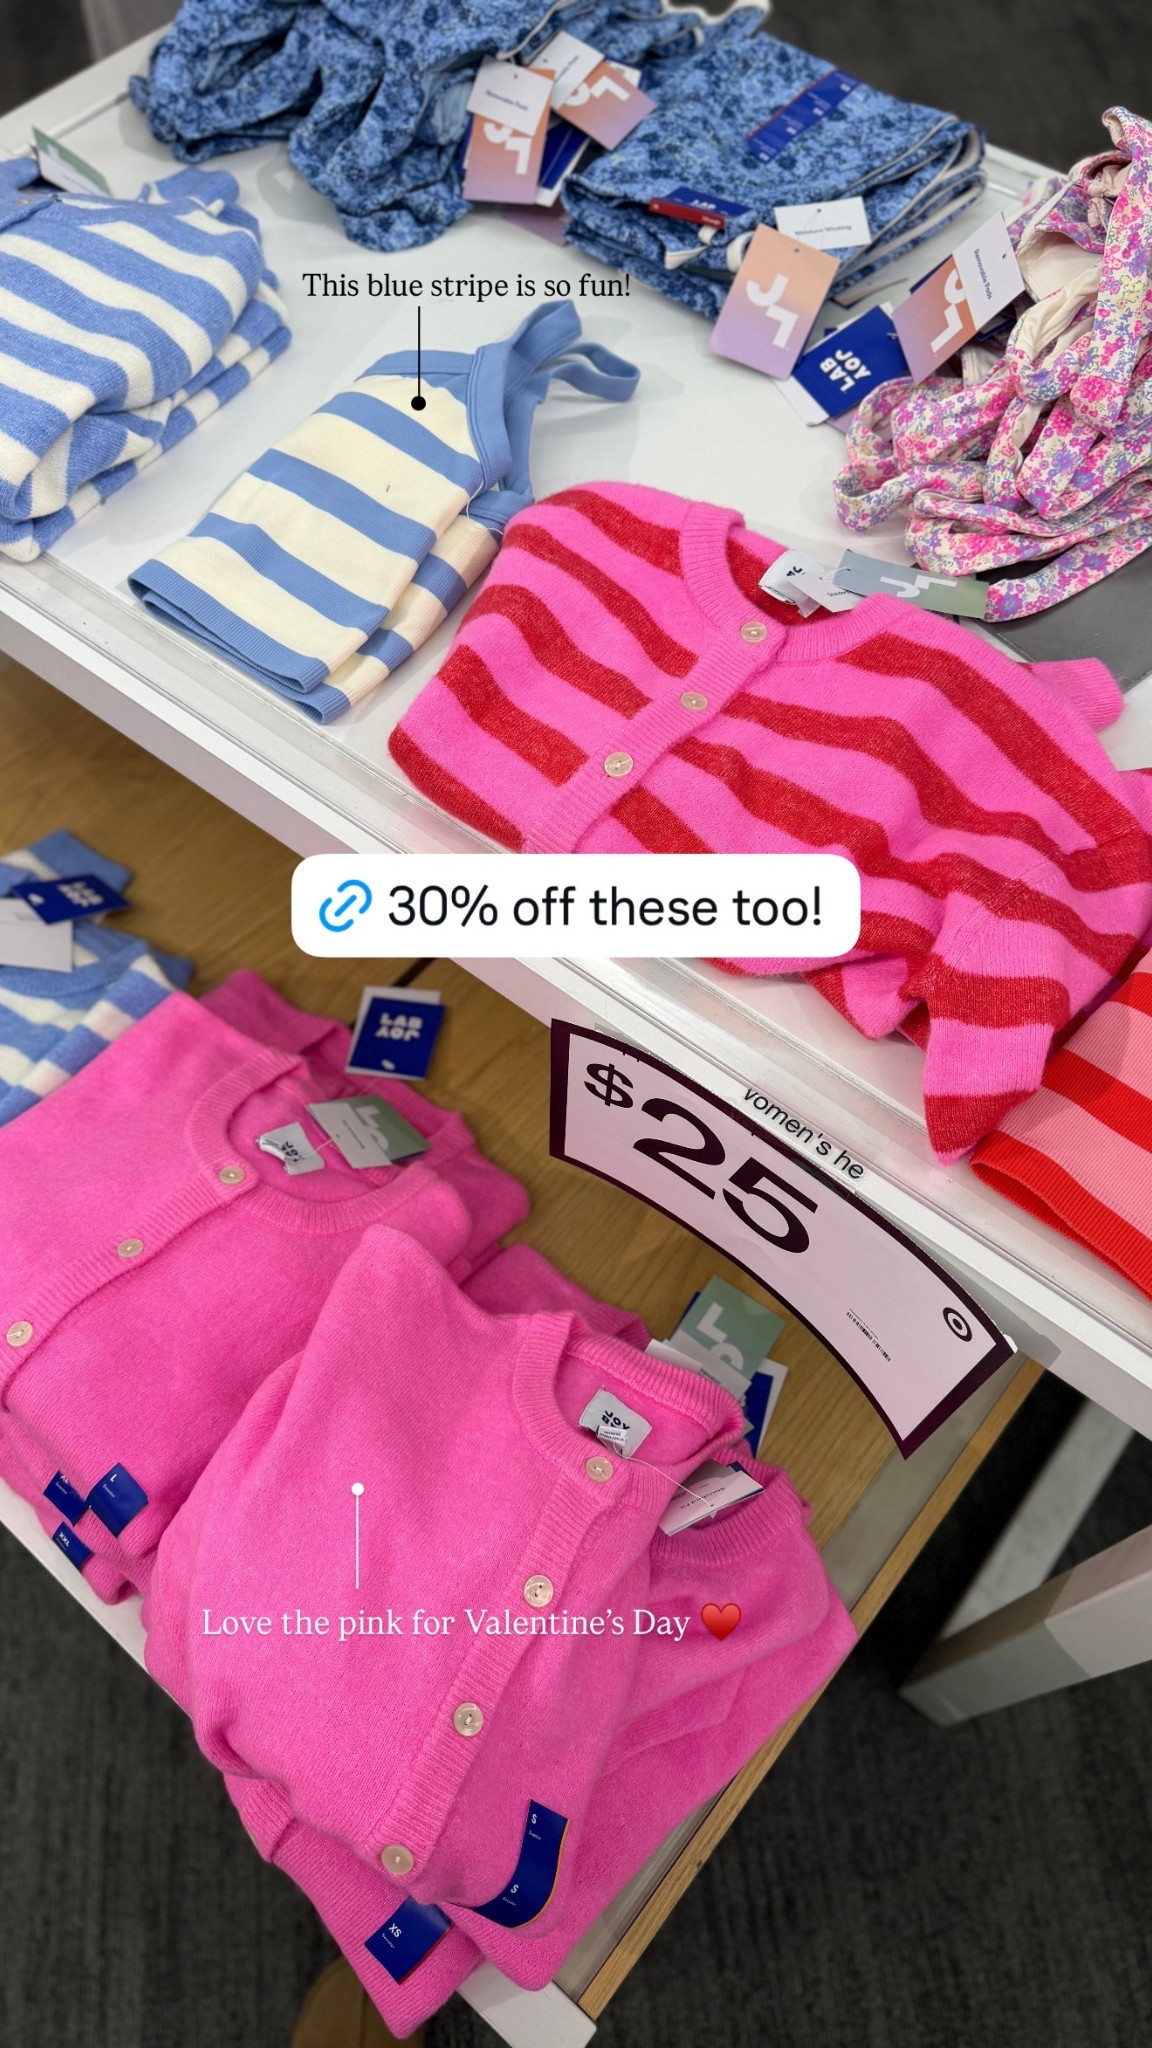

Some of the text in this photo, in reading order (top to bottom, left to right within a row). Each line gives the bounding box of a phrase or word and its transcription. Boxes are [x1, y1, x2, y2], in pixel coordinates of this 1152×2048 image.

[974, 248, 987, 283] Removable
[835, 349, 872, 380] JOY
[820, 356, 855, 393] LAB
[380, 1012, 423, 1031] LAB
[374, 1025, 420, 1042] JOY
[584, 1062, 818, 1254] $25
[605, 1410, 631, 1430] JOY
[109, 1473, 117, 1482] L
[59, 1532, 70, 1547] XXL
[531, 1814, 537, 1824] S
[510, 1884, 519, 1893] S
[388, 1922, 402, 1938] XS
